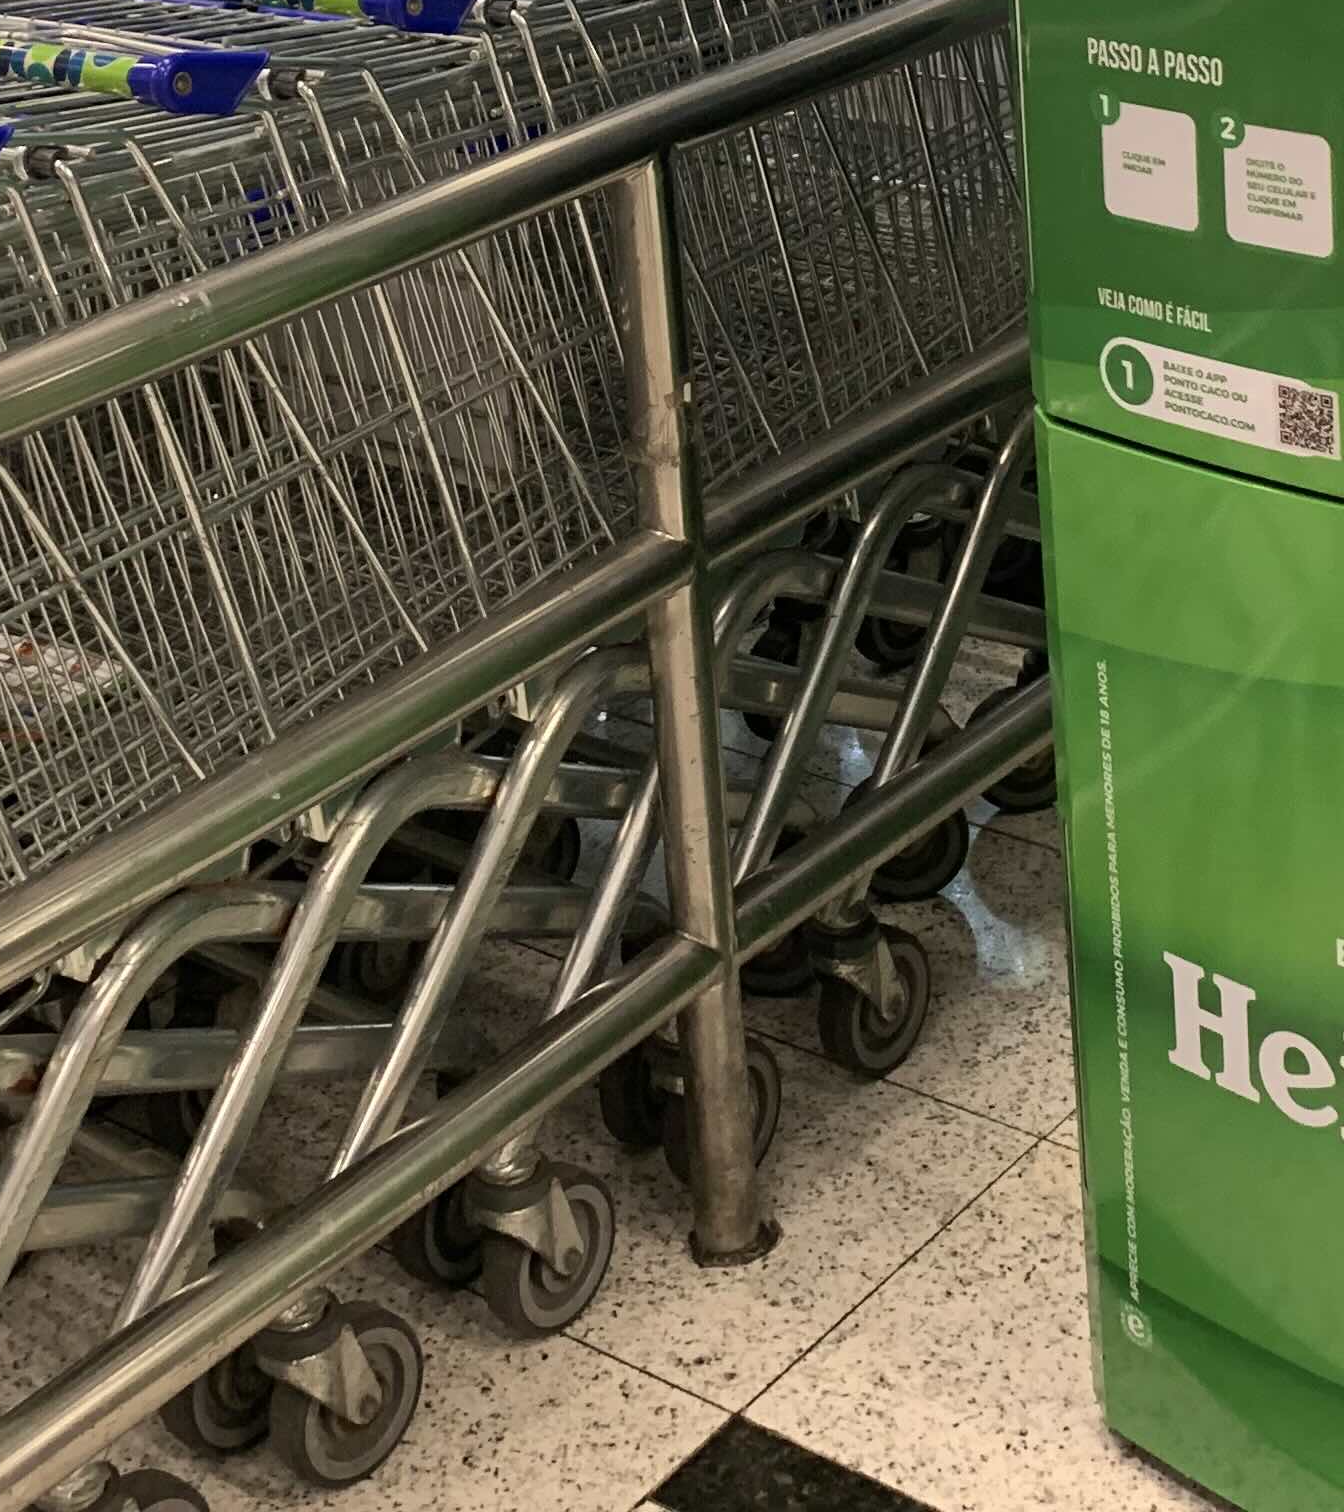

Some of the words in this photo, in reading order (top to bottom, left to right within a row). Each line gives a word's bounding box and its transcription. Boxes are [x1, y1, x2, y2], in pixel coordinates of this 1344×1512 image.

[1087, 37, 1143, 73] PASSO
[1147, 48, 1160, 76] A
[1164, 50, 1223, 87] PASSO
[1099, 94, 1108, 117] 1
[1220, 116, 1236, 140] 2
[1246, 193, 1279, 206] CLIQUE
[1282, 198, 1296, 208] EM
[1266, 184, 1308, 198] CELULAR
[1098, 287, 1125, 312] VEJA
[1128, 295, 1163, 321] COMO
[1166, 300, 1174, 324] É
[1176, 304, 1212, 333] FÁCIL
[1121, 360, 1134, 390] 1
[1163, 361, 1194, 375] BAIXE
[1195, 368, 1204, 379] O
[1163, 374, 1198, 391] PONTO
[1200, 385, 1229, 399] CACO
[1231, 392, 1248, 403] OU
[1165, 401, 1255, 432] PONTOCACO.COM
[1099, 709, 1110, 725] 18
[1101, 728, 1112, 750] DE
[1102, 752, 1116, 829] MENORES
[1107, 832, 1118, 873] PARA
[1109, 876, 1123, 958] PROIBIDOS
[1114, 960, 1128, 1037] CONSUMO
[1118, 1038, 1128, 1050] E
[1119, 1052, 1130, 1102] VENDA
[1128, 1239, 1140, 1304] APRECIE
